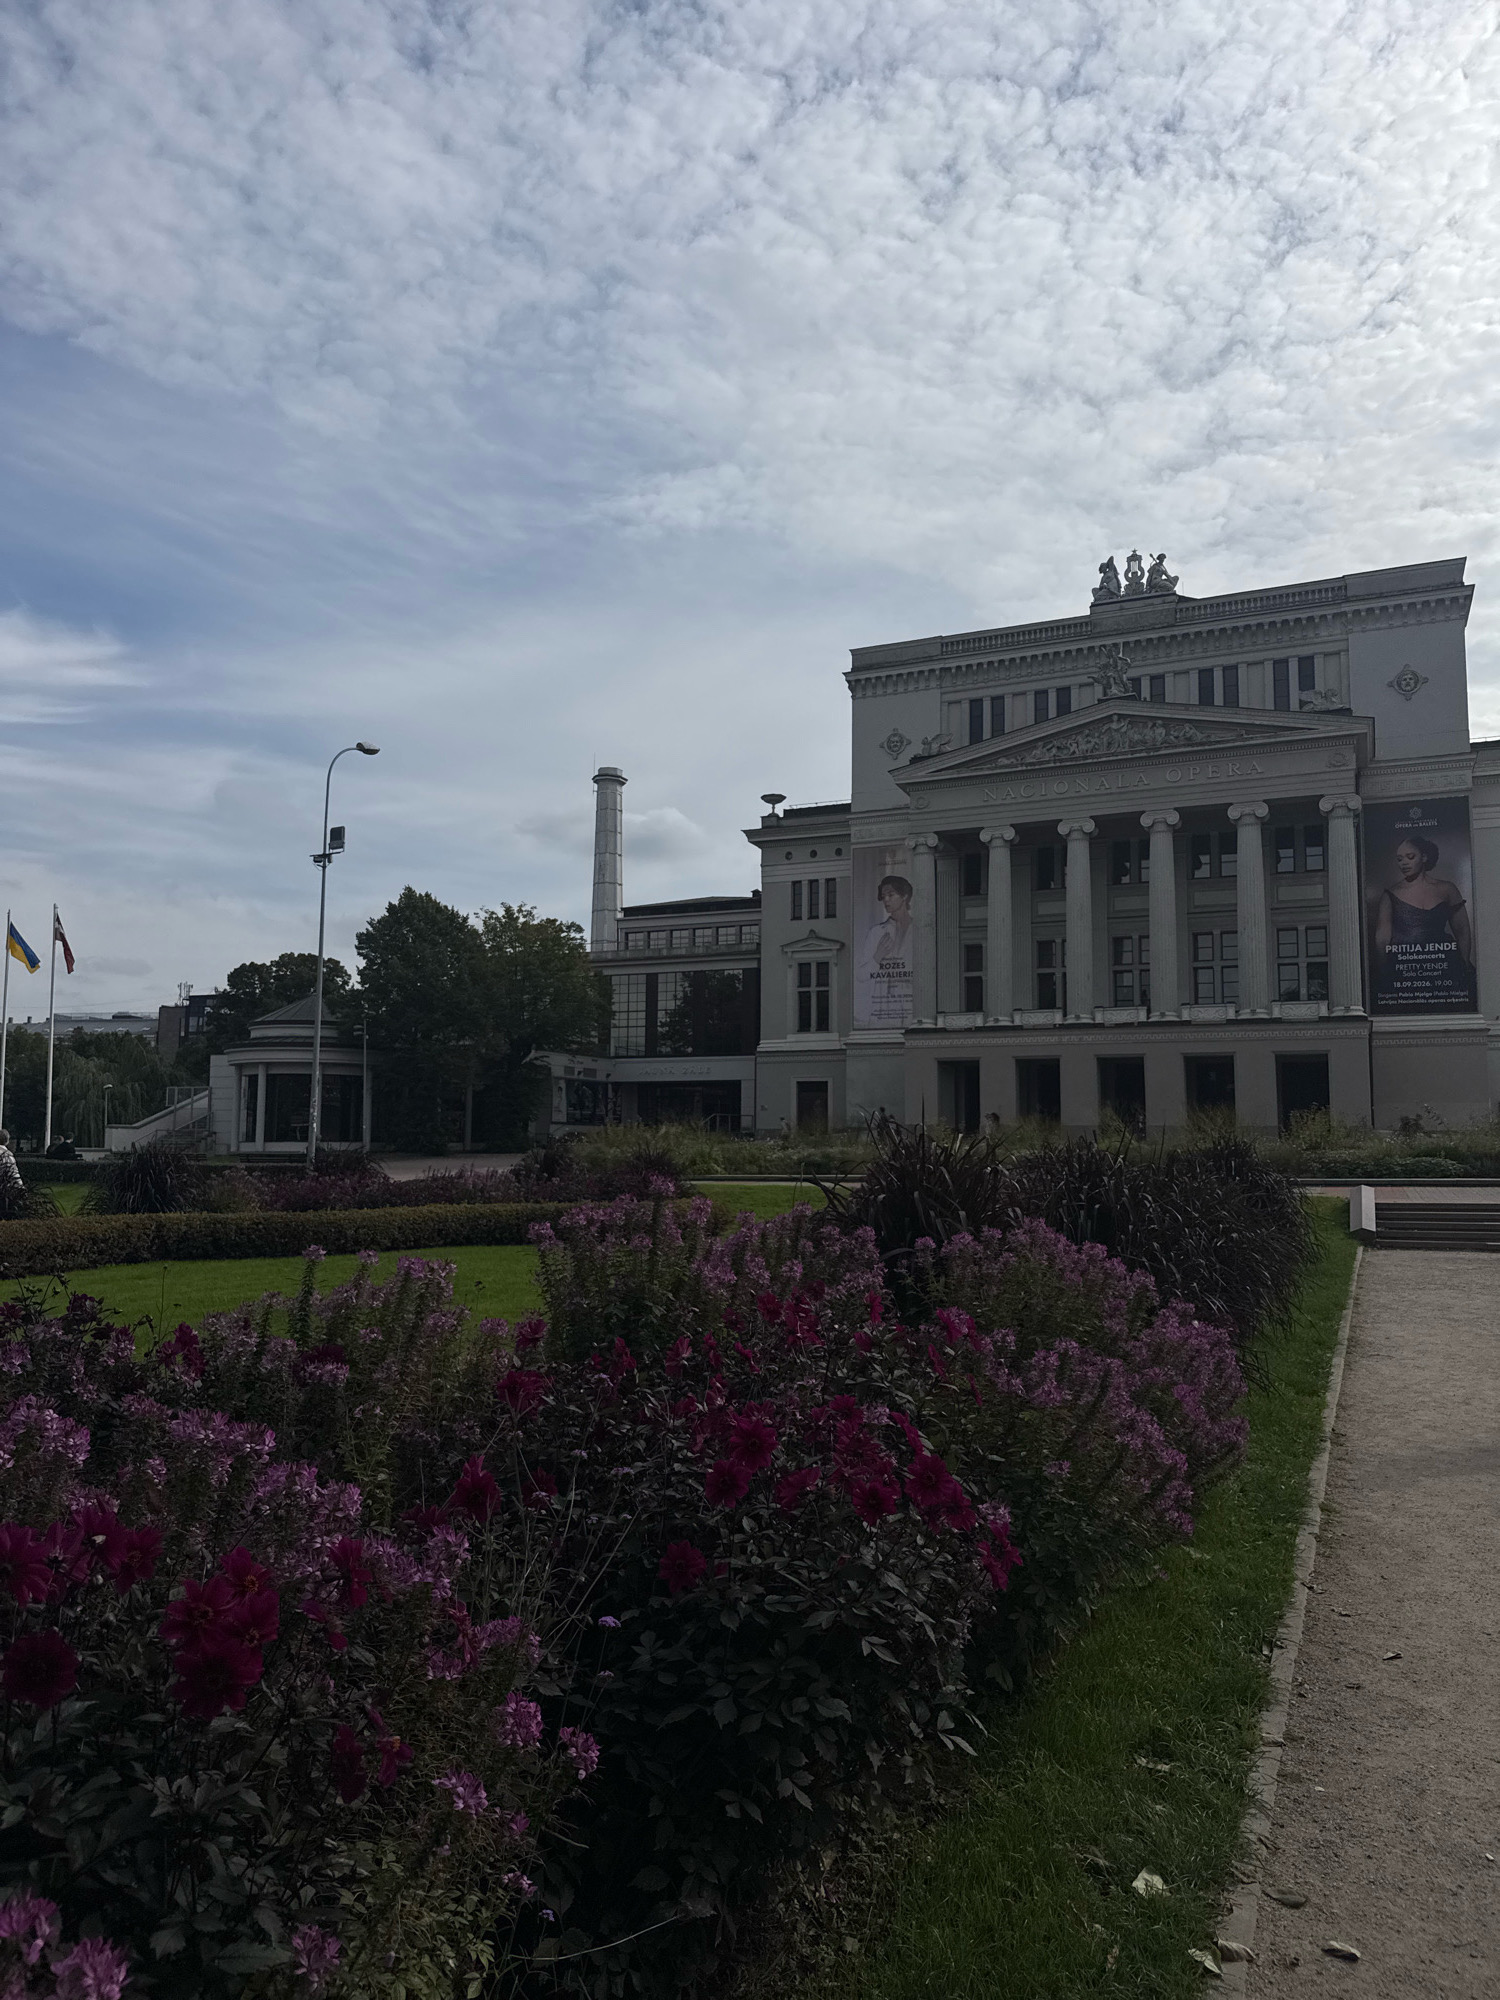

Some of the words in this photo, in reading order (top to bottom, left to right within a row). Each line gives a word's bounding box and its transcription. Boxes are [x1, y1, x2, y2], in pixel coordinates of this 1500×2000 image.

[982, 770, 1150, 802] NACIONĀLĀ
[1165, 761, 1264, 783] OPERA
[1385, 943, 1422, 953] PRITIJA
[1424, 942, 1457, 952] JENDE
[1397, 953, 1446, 961] Solokoncerts
[879, 961, 906, 970] ROZES
[1395, 963, 1421, 971] PRETTY
[1421, 962, 1449, 970] YENDE
